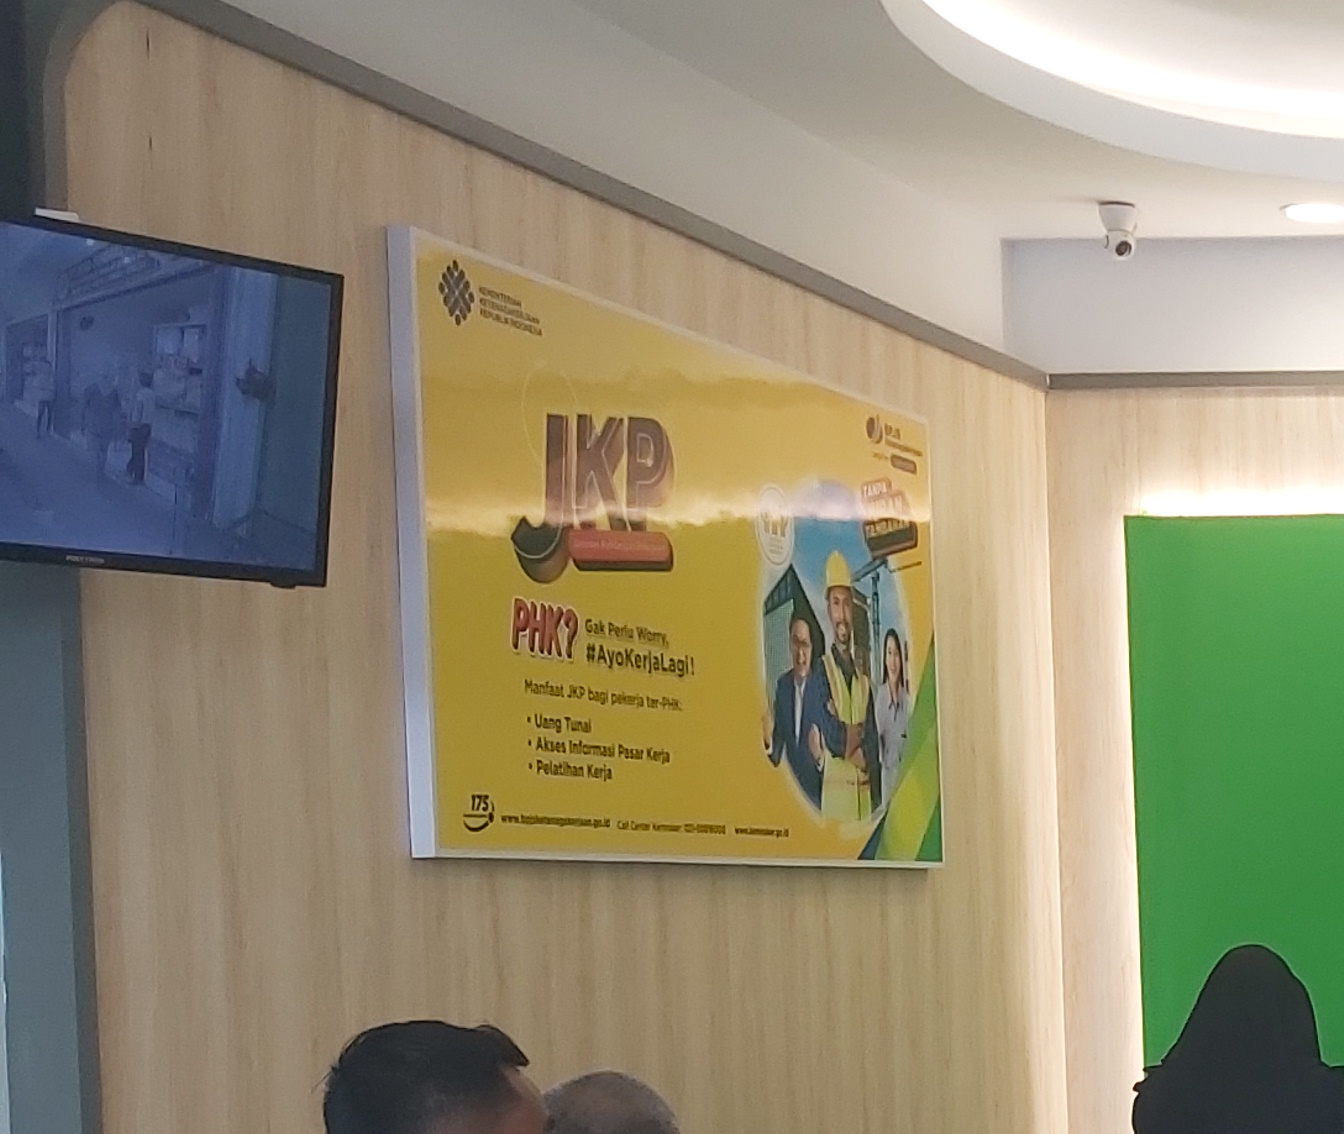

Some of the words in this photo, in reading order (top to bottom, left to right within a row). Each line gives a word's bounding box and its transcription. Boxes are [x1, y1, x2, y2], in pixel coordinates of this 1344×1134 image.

[511, 412, 675, 584] JKP
[511, 597, 579, 660] PHK?
[585, 619, 605, 634] Gak
[607, 622, 634, 640] Perlu
[524, 679, 564, 699] Manfaat
[567, 684, 586, 699] JKP
[588, 686, 609, 705] bagi
[534, 713, 562, 733] Uang
[564, 716, 592, 733] Tunai
[536, 736, 567, 754] Akses
[569, 740, 615, 758] Informasi
[618, 744, 644, 760] Pasar
[646, 747, 671, 764] Kerja
[536, 760, 584, 777] Pelatihan
[587, 763, 612, 782] Kerja
[471, 794, 490, 812] 175
